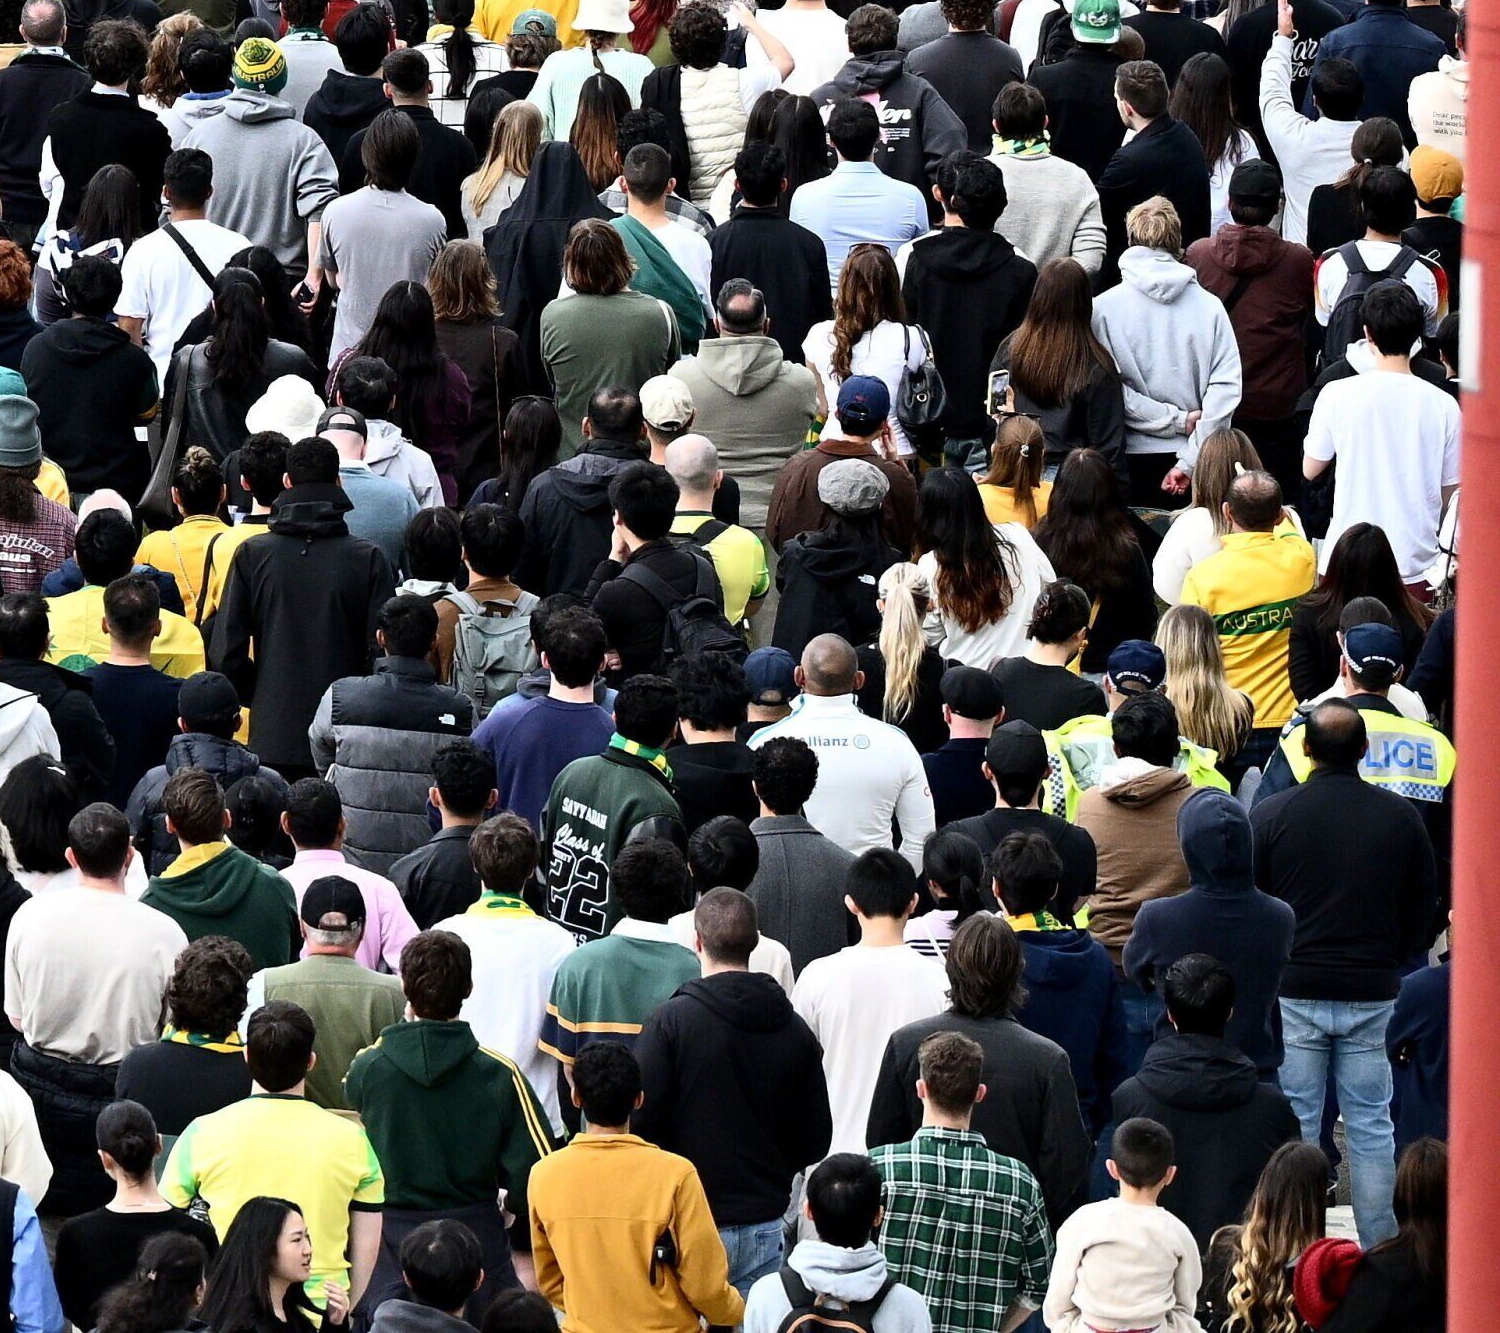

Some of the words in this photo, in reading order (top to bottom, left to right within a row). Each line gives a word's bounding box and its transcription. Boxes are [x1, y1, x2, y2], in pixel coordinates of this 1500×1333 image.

[561, 796, 607, 830] SAYYADAH
[555, 826, 592, 854] Class
[592, 841, 606, 863] of
[548, 844, 610, 936] 22
